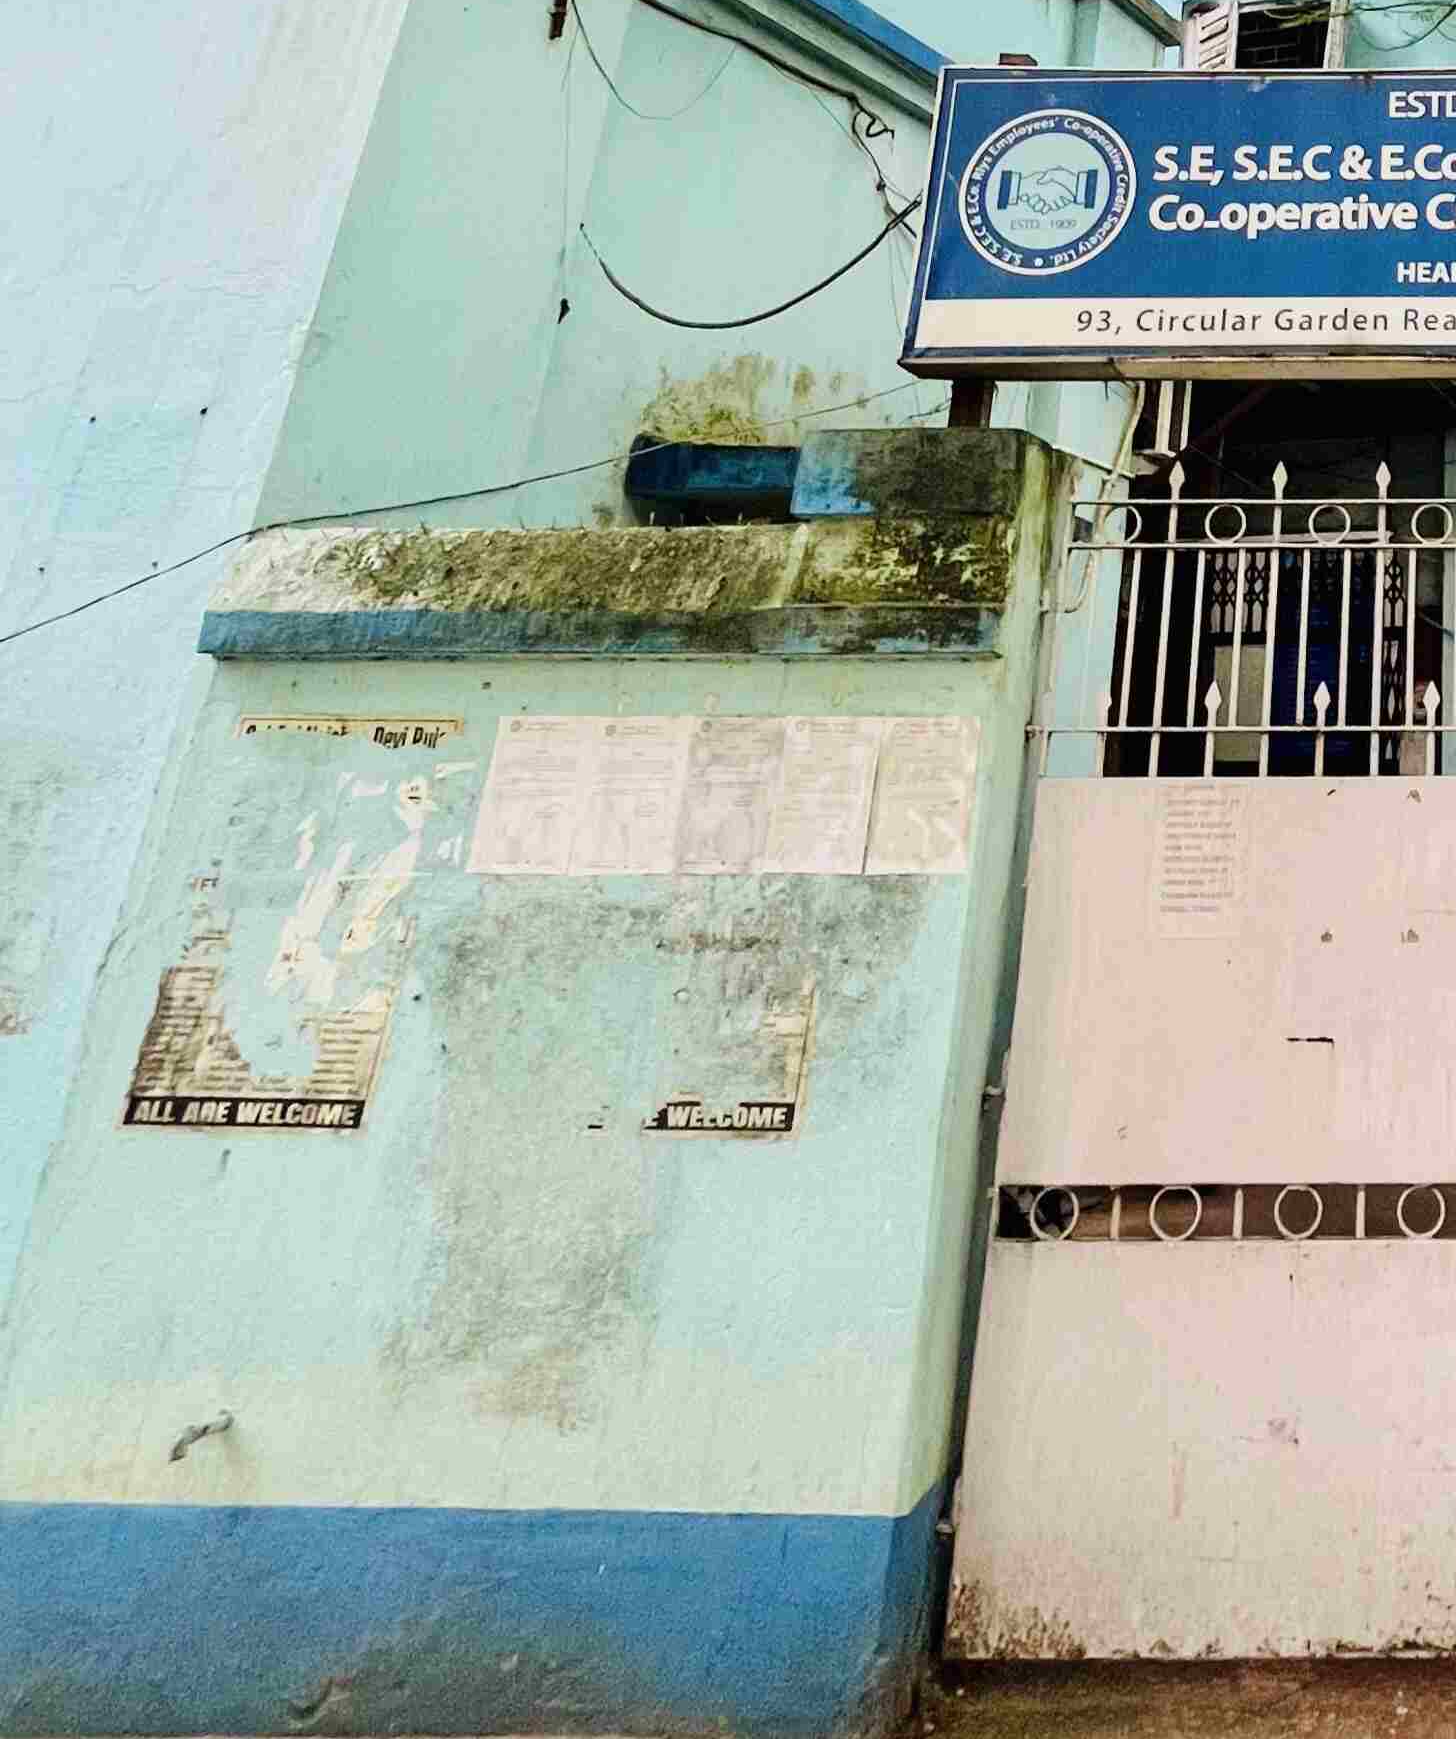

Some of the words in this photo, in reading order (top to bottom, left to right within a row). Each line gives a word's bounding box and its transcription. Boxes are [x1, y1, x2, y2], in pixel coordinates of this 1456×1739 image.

[1152, 145, 1224, 186] S.E,
[1232, 144, 1332, 181] S.E.C
[1338, 144, 1373, 181] &
[1148, 193, 1418, 240] Co-operative
[1076, 309, 1122, 335] 93,
[1136, 308, 1262, 332] Circular
[1274, 308, 1389, 331] Garden
[133, 1100, 176, 1123] ALL
[181, 1101, 231, 1124] ARE
[235, 1101, 357, 1126] WELCOME
